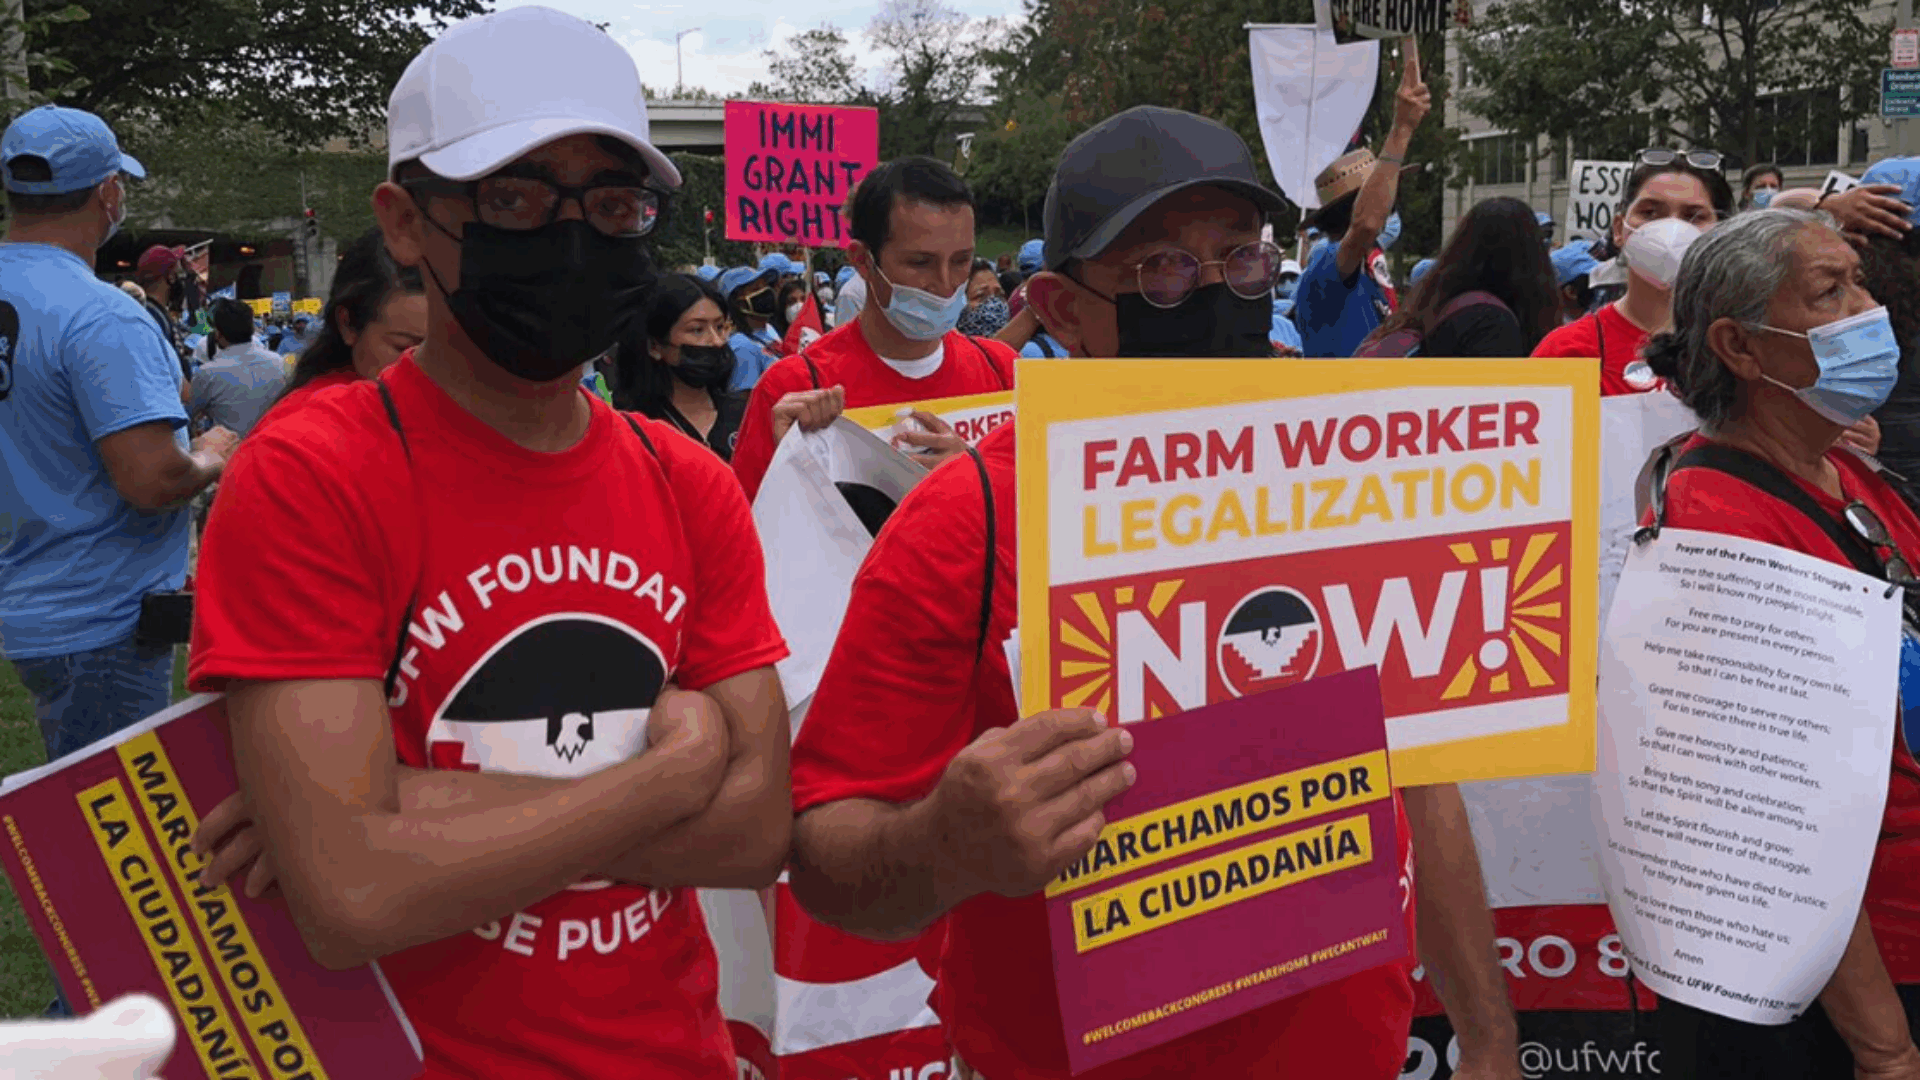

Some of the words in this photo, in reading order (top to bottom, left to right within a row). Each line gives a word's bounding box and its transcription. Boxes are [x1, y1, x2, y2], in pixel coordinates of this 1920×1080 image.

[1385, 0, 1450, 33] HOME
[760, 109, 834, 152] IMMI
[743, 154, 862, 196] GRANT
[738, 195, 853, 240] RIGHT
[1575, 201, 1621, 230] WO
[1083, 426, 1254, 490] FARM
[1274, 400, 1541, 468] WORKER
[1082, 457, 1542, 558] LEGALIZATION
[1675, 543, 1705, 556] Prayer
[1706, 547, 1717, 556] of
[1718, 549, 1737, 559] the
[1739, 553, 1766, 565] Farm
[466, 545, 687, 624] FOUNDAT
[1680, 579, 1691, 588] So
[1692, 580, 1695, 588] I
[1716, 583, 1745, 597] know
[1746, 592, 1763, 605] my
[1682, 568, 1696, 576] me
[1697, 569, 1714, 579] the
[1715, 573, 1761, 591] suffering
[1762, 582, 1774, 591] of
[1775, 585, 1791, 596] the
[1664, 618, 1680, 628] For
[1681, 623, 1699, 634] you
[1701, 626, 1717, 635] are
[1718, 629, 1758, 646] present
[1760, 637, 1771, 647] in
[1771, 642, 1799, 656] every
[1688, 607, 1710, 619] Free
[1711, 614, 1728, 623] me
[1729, 616, 1741, 626] to
[1742, 620, 1766, 633] pray
[1767, 624, 1781, 635] for
[1116, 566, 1509, 724] NOW!
[1644, 642, 1665, 654] Help
[1666, 647, 1681, 655] me
[1683, 648, 1704, 659] take
[1705, 652, 1775, 677] responsibility
[1776, 668, 1790, 679] for
[1791, 674, 1808, 686] my
[1809, 679, 1831, 690] own
[1677, 661, 1690, 671] So
[1690, 664, 1712, 676] that
[1713, 668, 1717, 677] I
[1719, 672, 1738, 681] can
[1740, 674, 1754, 685] be
[1755, 678, 1776, 690] free
[1776, 683, 1788, 693] at
[1648, 683, 1674, 696] Grant
[1674, 691, 1690, 700] me
[1691, 695, 1733, 712] courage
[1736, 703, 1747, 712] to
[1749, 708, 1777, 719] serve
[1778, 714, 1795, 726] my
[1662, 701, 1679, 712] For
[1679, 705, 1689, 714] in
[1691, 707, 1727, 721] service
[1728, 714, 1757, 728] there
[1758, 722, 1767, 730] is
[1768, 724, 1790, 736] true
[1655, 727, 1676, 738] Give
[1677, 733, 1693, 742] me
[1694, 736, 1737, 754] honesty
[1738, 746, 1759, 758] and
[1671, 744, 1675, 752] I
[1676, 747, 1694, 756] can
[1696, 749, 1723, 762] work
[1724, 755, 1748, 768] with
[1749, 762, 1777, 776] other
[1668, 772, 1693, 785] forth
[1694, 780, 1720, 794] song
[1722, 785, 1743, 797] and
[1058, 785, 1292, 883] MARCHAMOS
[1301, 766, 1373, 809] POR
[1640, 808, 1654, 819] Let
[1655, 811, 1671, 823] the
[1671, 816, 1698, 832] Spirit
[1699, 822, 1740, 840] flourish
[1741, 833, 1763, 846] and
[1676, 787, 1703, 803] Spirit
[1704, 793, 1724, 806] will
[1724, 799, 1740, 810] be
[1740, 803, 1766, 817] alive
[1766, 812, 1804, 831] among
[1666, 827, 1683, 840] will
[1684, 834, 1713, 847] never
[1715, 841, 1734, 853] tire
[1734, 845, 1747, 856] of
[1748, 849, 1767, 862] the
[1084, 898, 1132, 939] LA
[1139, 825, 1361, 920] CIUDADANÍA
[1656, 869, 1678, 885] they
[1678, 876, 1704, 890] have
[1704, 884, 1735, 901] given
[1737, 894, 1750, 903] us
[1669, 858, 1697, 873] those
[1698, 866, 1723, 881] who
[1724, 873, 1751, 888] have
[1752, 881, 1776, 895] died
[1776, 887, 1792, 899] for
[89, 793, 131, 850] LA
[119, 854, 253, 1080] CIUDADANÍ
[1647, 897, 1668, 910] love
[1668, 905, 1692, 917] even
[1693, 911, 1724, 926] those
[1726, 919, 1750, 932] who
[1751, 926, 1775, 939] hate
[1657, 915, 1674, 925] can
[1674, 919, 1713, 939] change
[1714, 930, 1733, 943] the
[1493, 935, 1577, 979] RO
[1673, 948, 1705, 964] Amen
[1082, 981, 1233, 1045] #WELCOMEBACKCONGRESS
[1235, 954, 1310, 992] #WEAREHOME
[1311, 928, 1389, 965] #WECANTWAIT
[1686, 977, 1714, 992] UFW
[1713, 985, 1759, 1003] Founder
